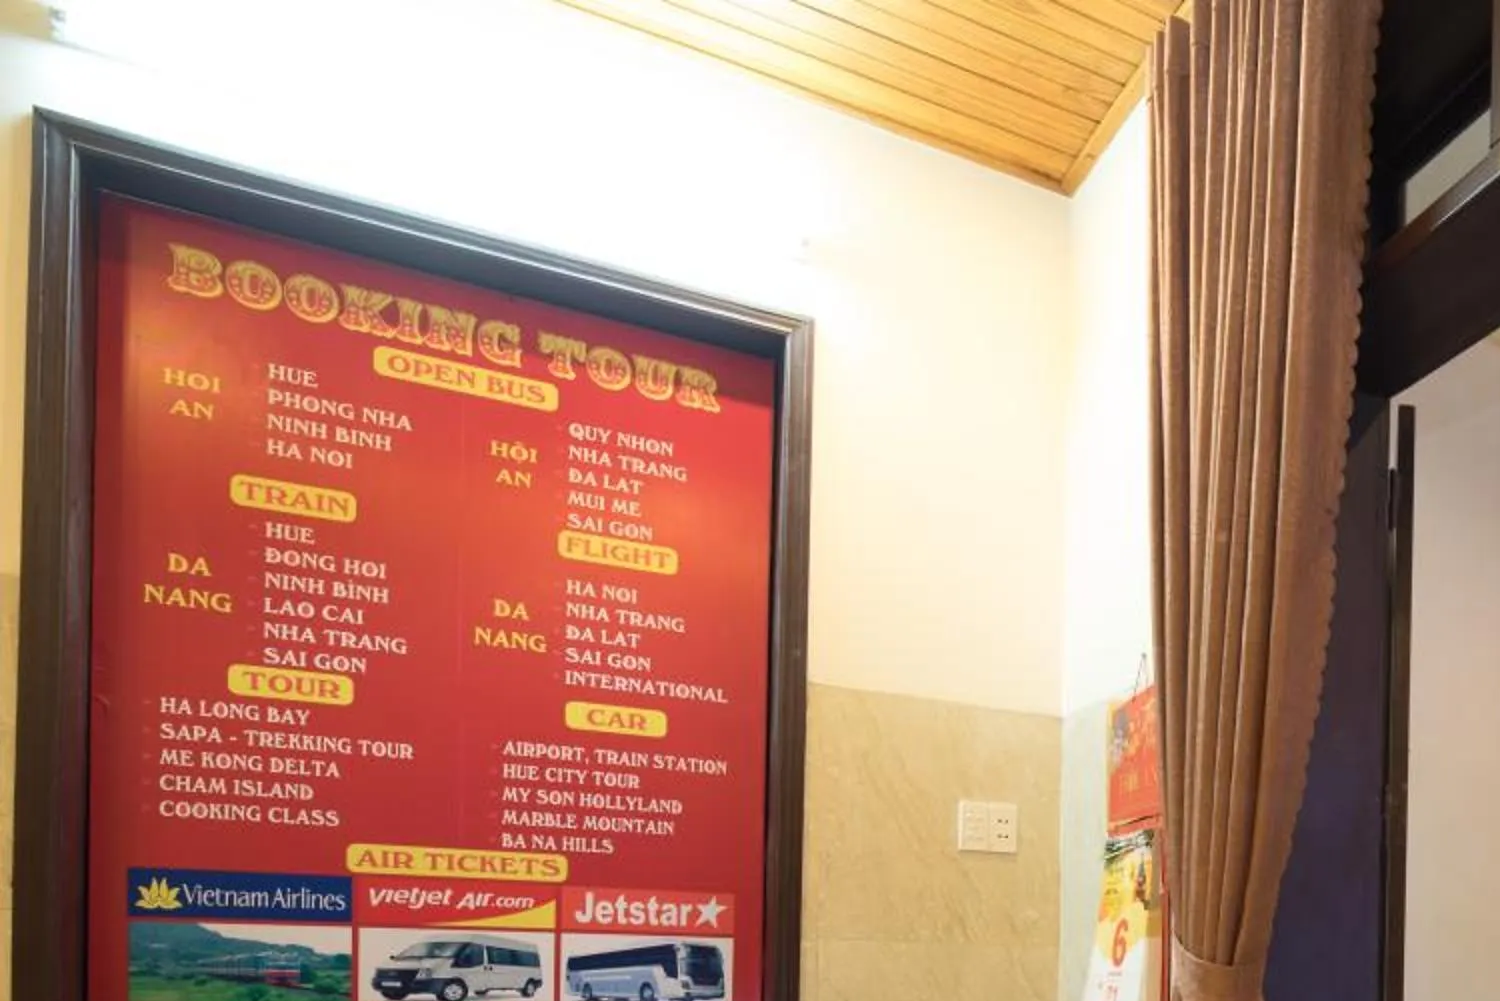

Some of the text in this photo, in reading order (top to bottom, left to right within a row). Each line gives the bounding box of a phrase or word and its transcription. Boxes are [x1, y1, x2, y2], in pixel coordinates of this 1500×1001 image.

[167, 243, 721, 413] BOOKING TOUR
[387, 354, 546, 403] OPEN BUS
[169, 399, 214, 421] AN
[267, 389, 413, 432] PHONG NHA
[266, 414, 393, 451] NINH BINH
[568, 423, 674, 456] QUY NHON
[266, 439, 353, 469] HA NOI
[568, 445, 688, 482] NHA TRANG
[495, 467, 532, 488] AN
[603, 475, 645, 495] LAT
[238, 478, 350, 517] TRAIN
[567, 491, 642, 518] MUI ME
[265, 521, 316, 544] HUE
[567, 513, 654, 541] SAI GON
[167, 552, 212, 576] DA
[565, 535, 671, 571] FLIGHT
[343, 558, 387, 579] HOI
[143, 583, 233, 613] NANG
[264, 572, 325, 596] NINH
[566, 579, 638, 604] HA NOI
[264, 597, 364, 625] LAO CAI
[493, 598, 530, 621] DA
[565, 602, 686, 633] NHA TRANG
[263, 622, 408, 655] NHA TRANG
[473, 626, 548, 653] NANG
[600, 630, 641, 649] LAT
[263, 647, 367, 673] SAI GON
[564, 648, 652, 672] SAI GON
[242, 671, 341, 700] TOUR
[564, 670, 729, 704] INTERNATIONAL
[160, 697, 311, 726] HA LONG BAY
[586, 708, 649, 732] CAR
[159, 723, 222, 744] SAPA
[243, 730, 352, 754] TREKKING
[357, 739, 414, 760] TOUR
[159, 749, 341, 779] ME KONG DELTA
[502, 741, 728, 776] AIRPORT, TRAIN STATION
[159, 775, 314, 801] CHAM ISLAND
[502, 764, 641, 789] HUE CITY TOUR
[159, 800, 341, 827] COOKING CLASS
[502, 788, 683, 815] MY SON HOLLYLAND
[502, 810, 675, 836] MARBLE MOUNTAIN
[502, 833, 615, 854] BA NA HILLS
[355, 849, 561, 877] AIR TICKETS
[181, 881, 346, 911] Vietnam Airlines
[574, 891, 691, 927] Jetstar
[1111, 917, 1129, 968] 6
